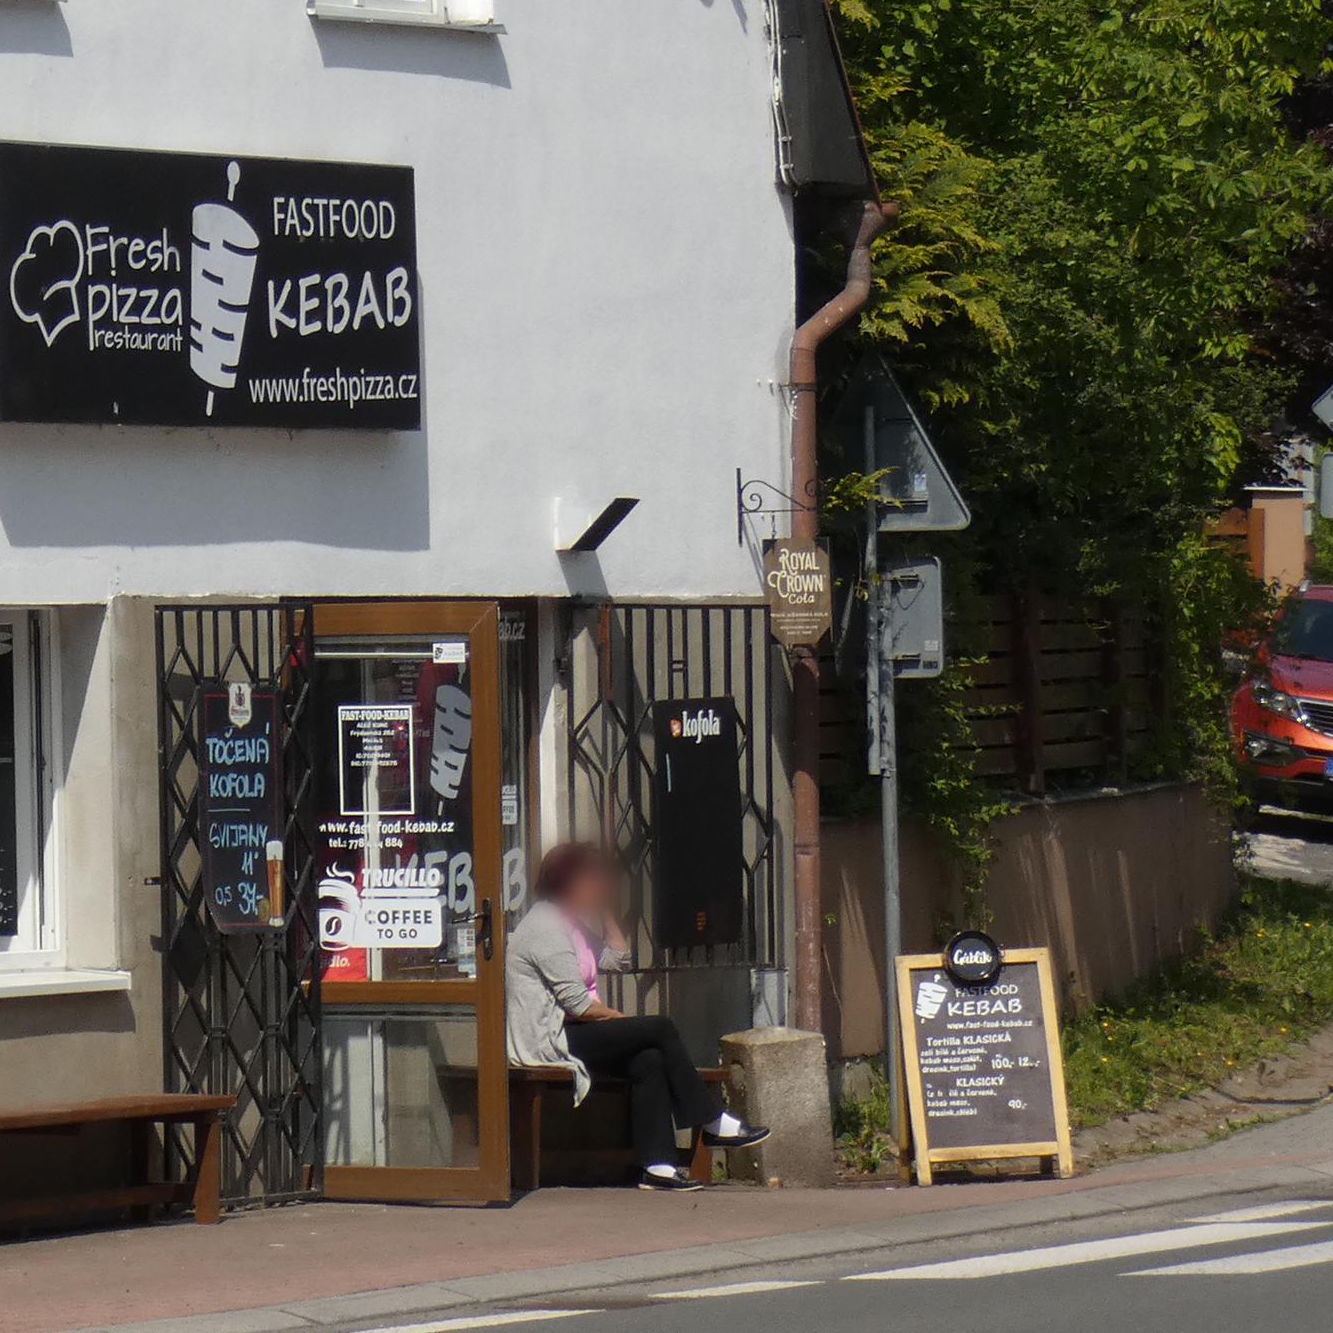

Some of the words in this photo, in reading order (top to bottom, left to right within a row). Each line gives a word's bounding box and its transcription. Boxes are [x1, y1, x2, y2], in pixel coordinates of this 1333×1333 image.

[273, 197, 396, 240] FASTFOOD
[86, 223, 181, 276] Fresh
[87, 280, 183, 351] pizza
[267, 266, 413, 339] KEBAB
[93, 325, 184, 352] restaurant
[248, 366, 418, 410] www.freshpizza.cz
[779, 548, 821, 575] ROYAL
[767, 571, 824, 599] CROWN
[788, 593, 816, 604] Cola
[682, 709, 722, 744] kofola
[205, 722, 270, 766] TOČENÁ
[209, 773, 266, 799] KOFOLA
[209, 822, 269, 849] SVIJANY
[361, 867, 442, 888] TRUCILLO
[377, 929, 394, 939] TO
[399, 929, 418, 939] GO
[955, 984, 1019, 998] FASTFOOD
[947, 998, 1023, 1017] KEBAB
[926, 1037, 962, 1047] Tortilla
[963, 1031, 1013, 1046] KLASICKÁ
[956, 1073, 1005, 1088] KLASICKÝ
